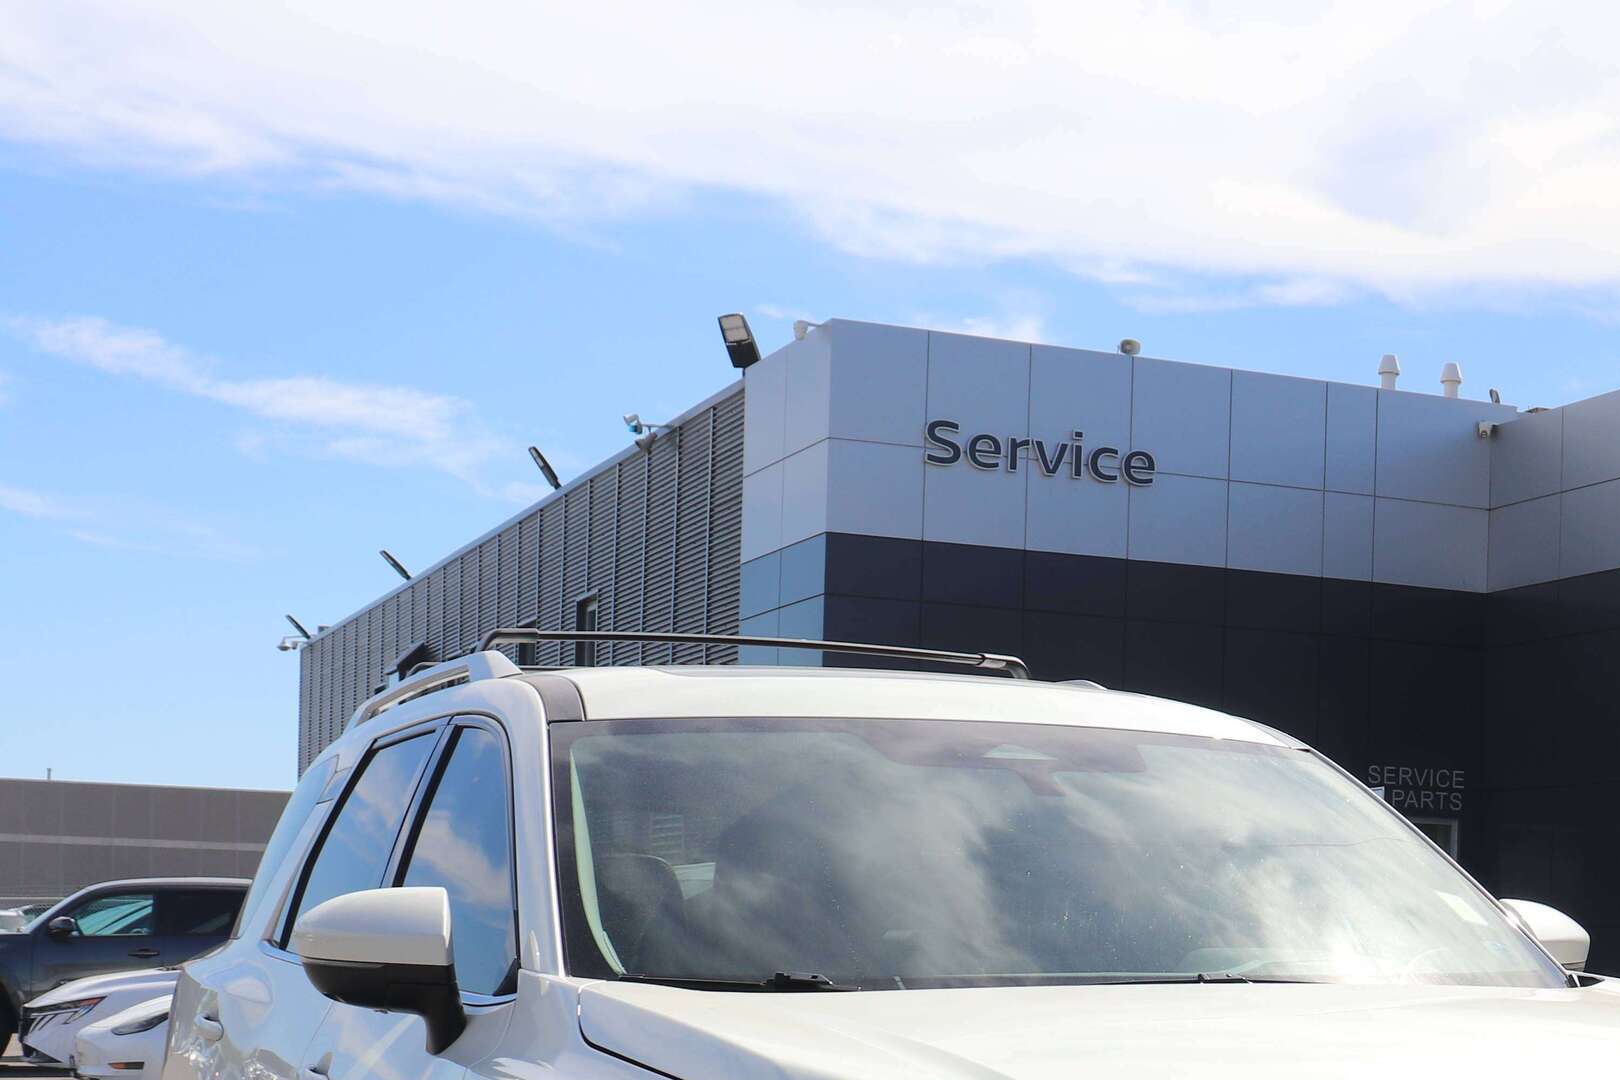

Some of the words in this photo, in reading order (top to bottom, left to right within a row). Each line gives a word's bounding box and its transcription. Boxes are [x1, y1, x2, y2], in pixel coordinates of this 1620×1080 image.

[924, 418, 1157, 488] Service
[1367, 765, 1465, 789] SERVICE
[1391, 789, 1463, 811] PARTS
